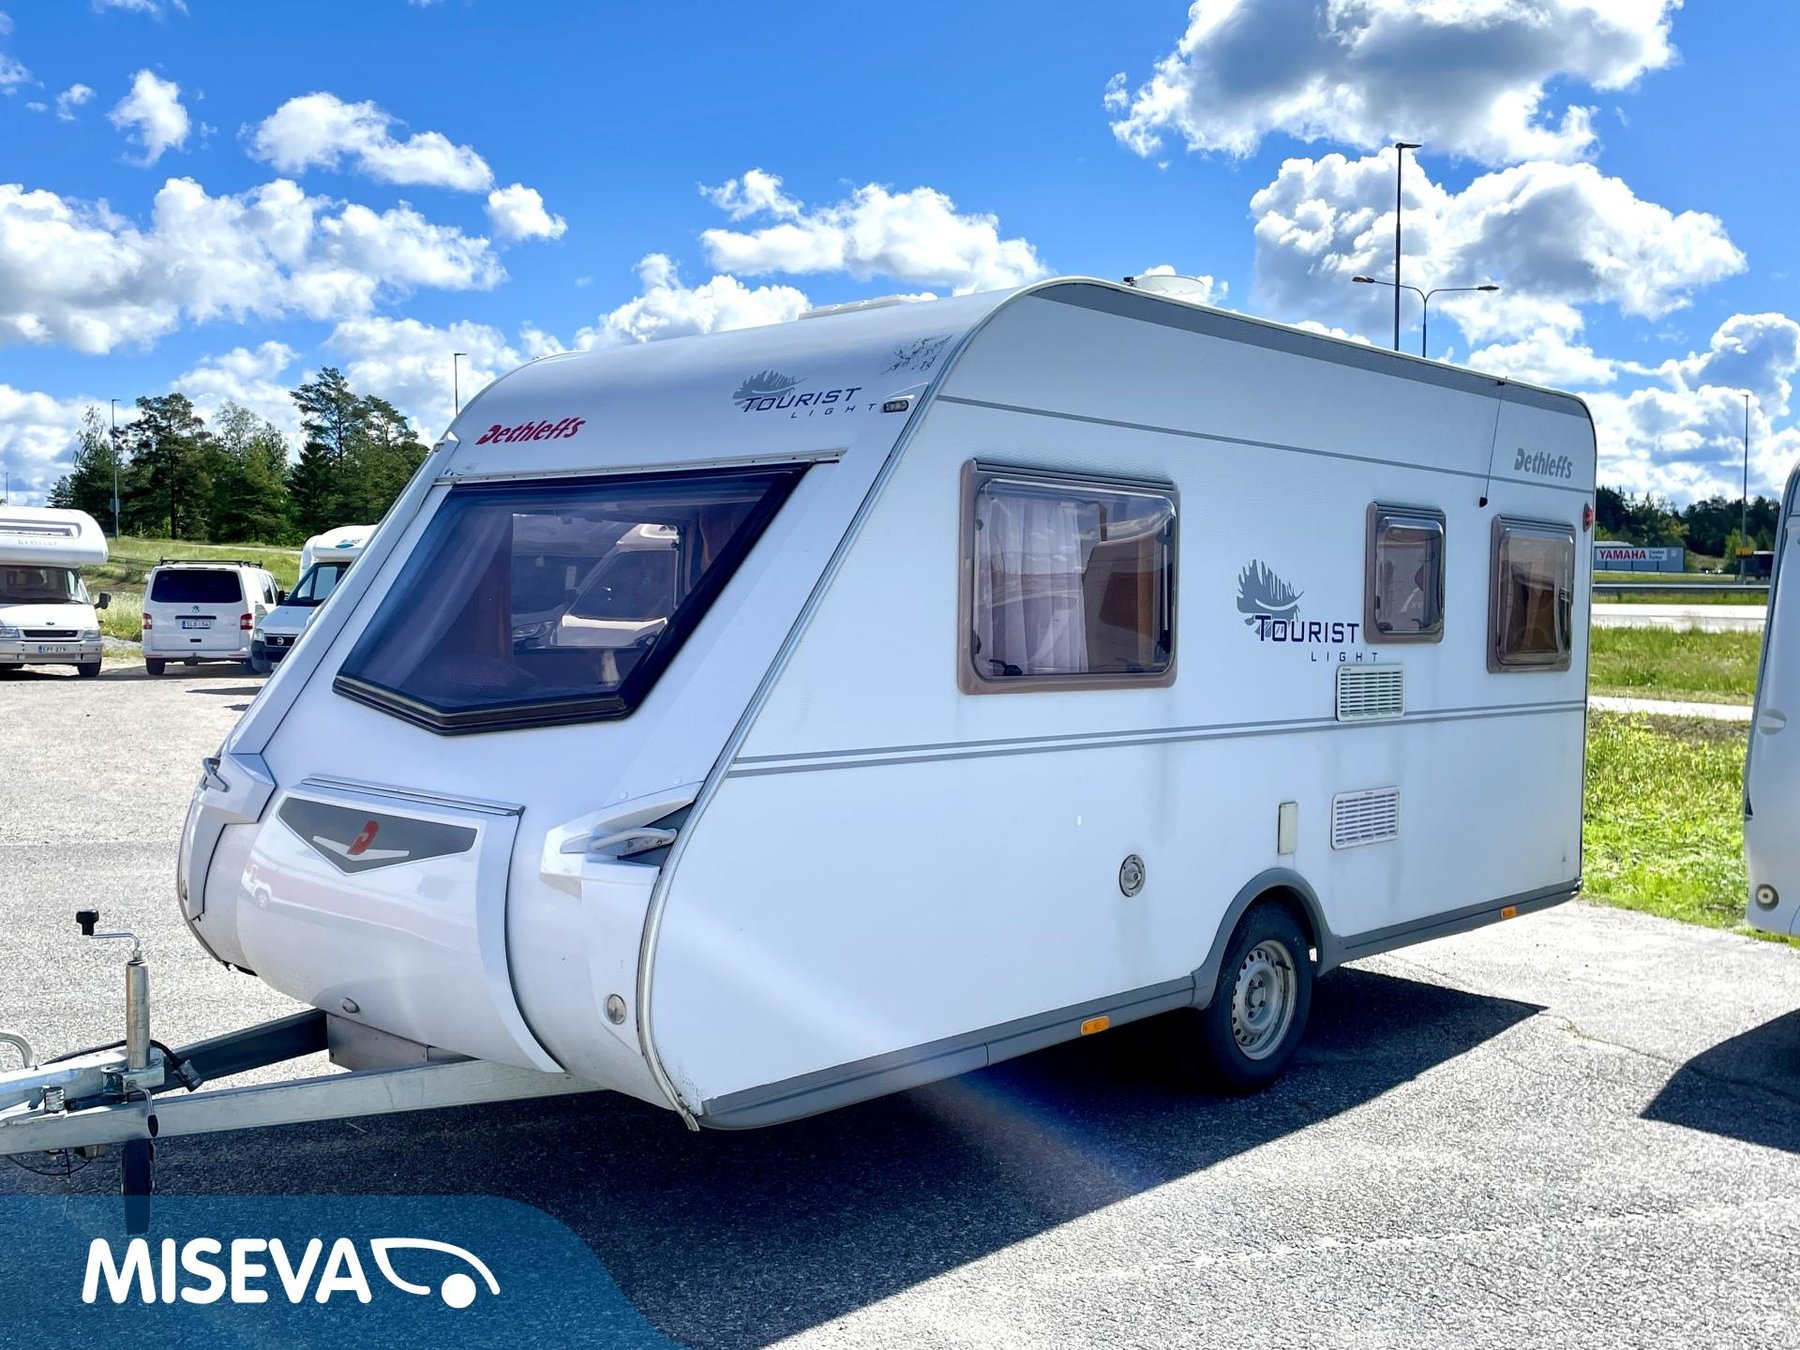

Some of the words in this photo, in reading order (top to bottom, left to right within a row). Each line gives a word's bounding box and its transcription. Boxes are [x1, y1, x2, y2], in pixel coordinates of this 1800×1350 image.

[743, 387, 862, 413] TOURIST
[790, 403, 877, 418] LIGHT
[475, 417, 587, 445] Dethleffs
[1514, 447, 1573, 479] Dethleffs
[1599, 549, 1647, 560] YAMAHA
[1255, 614, 1360, 643] TOURIST
[1310, 651, 1378, 662] LIGHT
